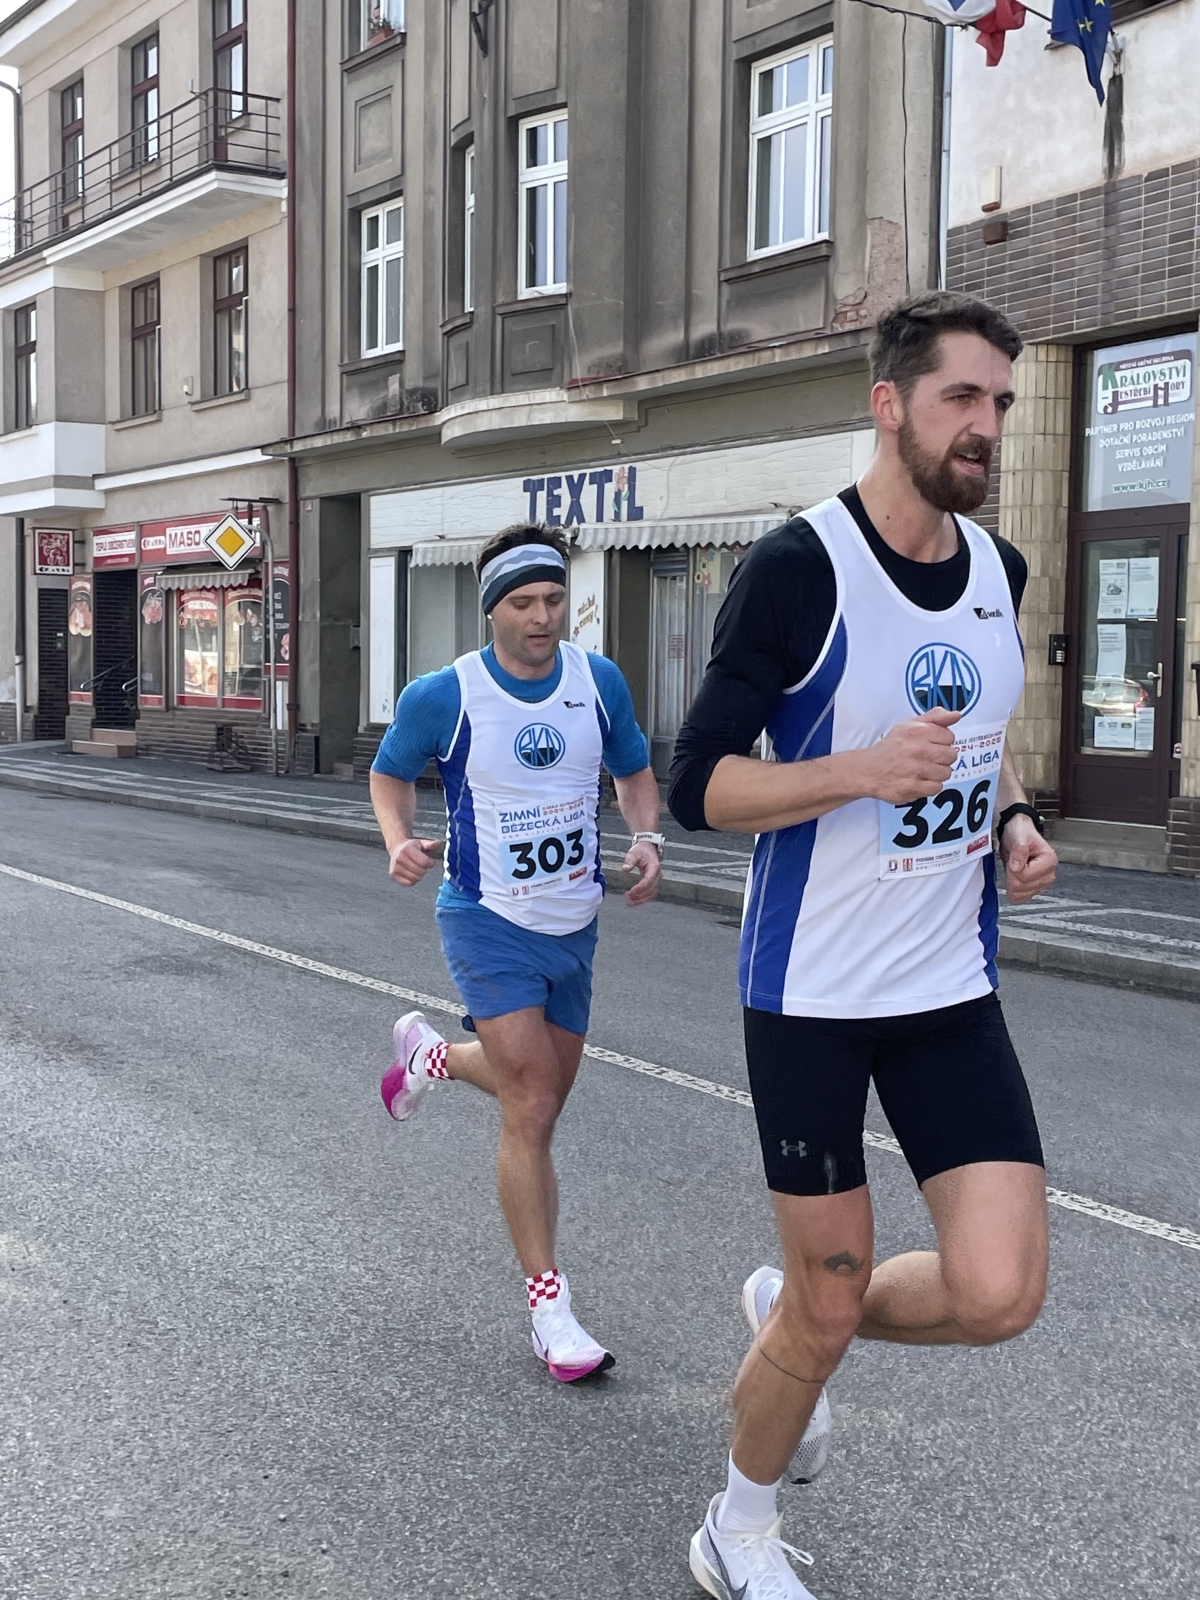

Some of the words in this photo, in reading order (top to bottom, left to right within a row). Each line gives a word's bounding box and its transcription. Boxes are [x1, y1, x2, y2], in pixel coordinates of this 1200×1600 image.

[1102, 362, 1187, 391] KRÁLOVSTVÍ
[1103, 387, 1151, 414] JESTŘEBÍ
[1153, 381, 1185, 408] HORY
[1085, 424, 1118, 437] PARTNER
[1120, 421, 1135, 432] PRO
[1136, 417, 1165, 429] ROZVOJ
[1099, 434, 1131, 448] DOTAČNÍ
[1133, 426, 1184, 443] PORADENSTVÍ
[1115, 448, 1141, 459] SERVIS
[1142, 443, 1167, 456] OBCÍM
[1113, 480, 1167, 491] www.kjh.cz
[523, 466, 643, 528] TEXTIL
[169, 530, 201, 548] MASO
[954, 736, 1001, 752] 024-2025
[972, 750, 1000, 768] LIGA
[500, 805, 541, 823] ZIMNÍ
[501, 816, 561, 834] BĚŽECKÁ
[564, 810, 585, 823] LIGA
[892, 779, 991, 848] 326
[509, 828, 584, 880] 303
